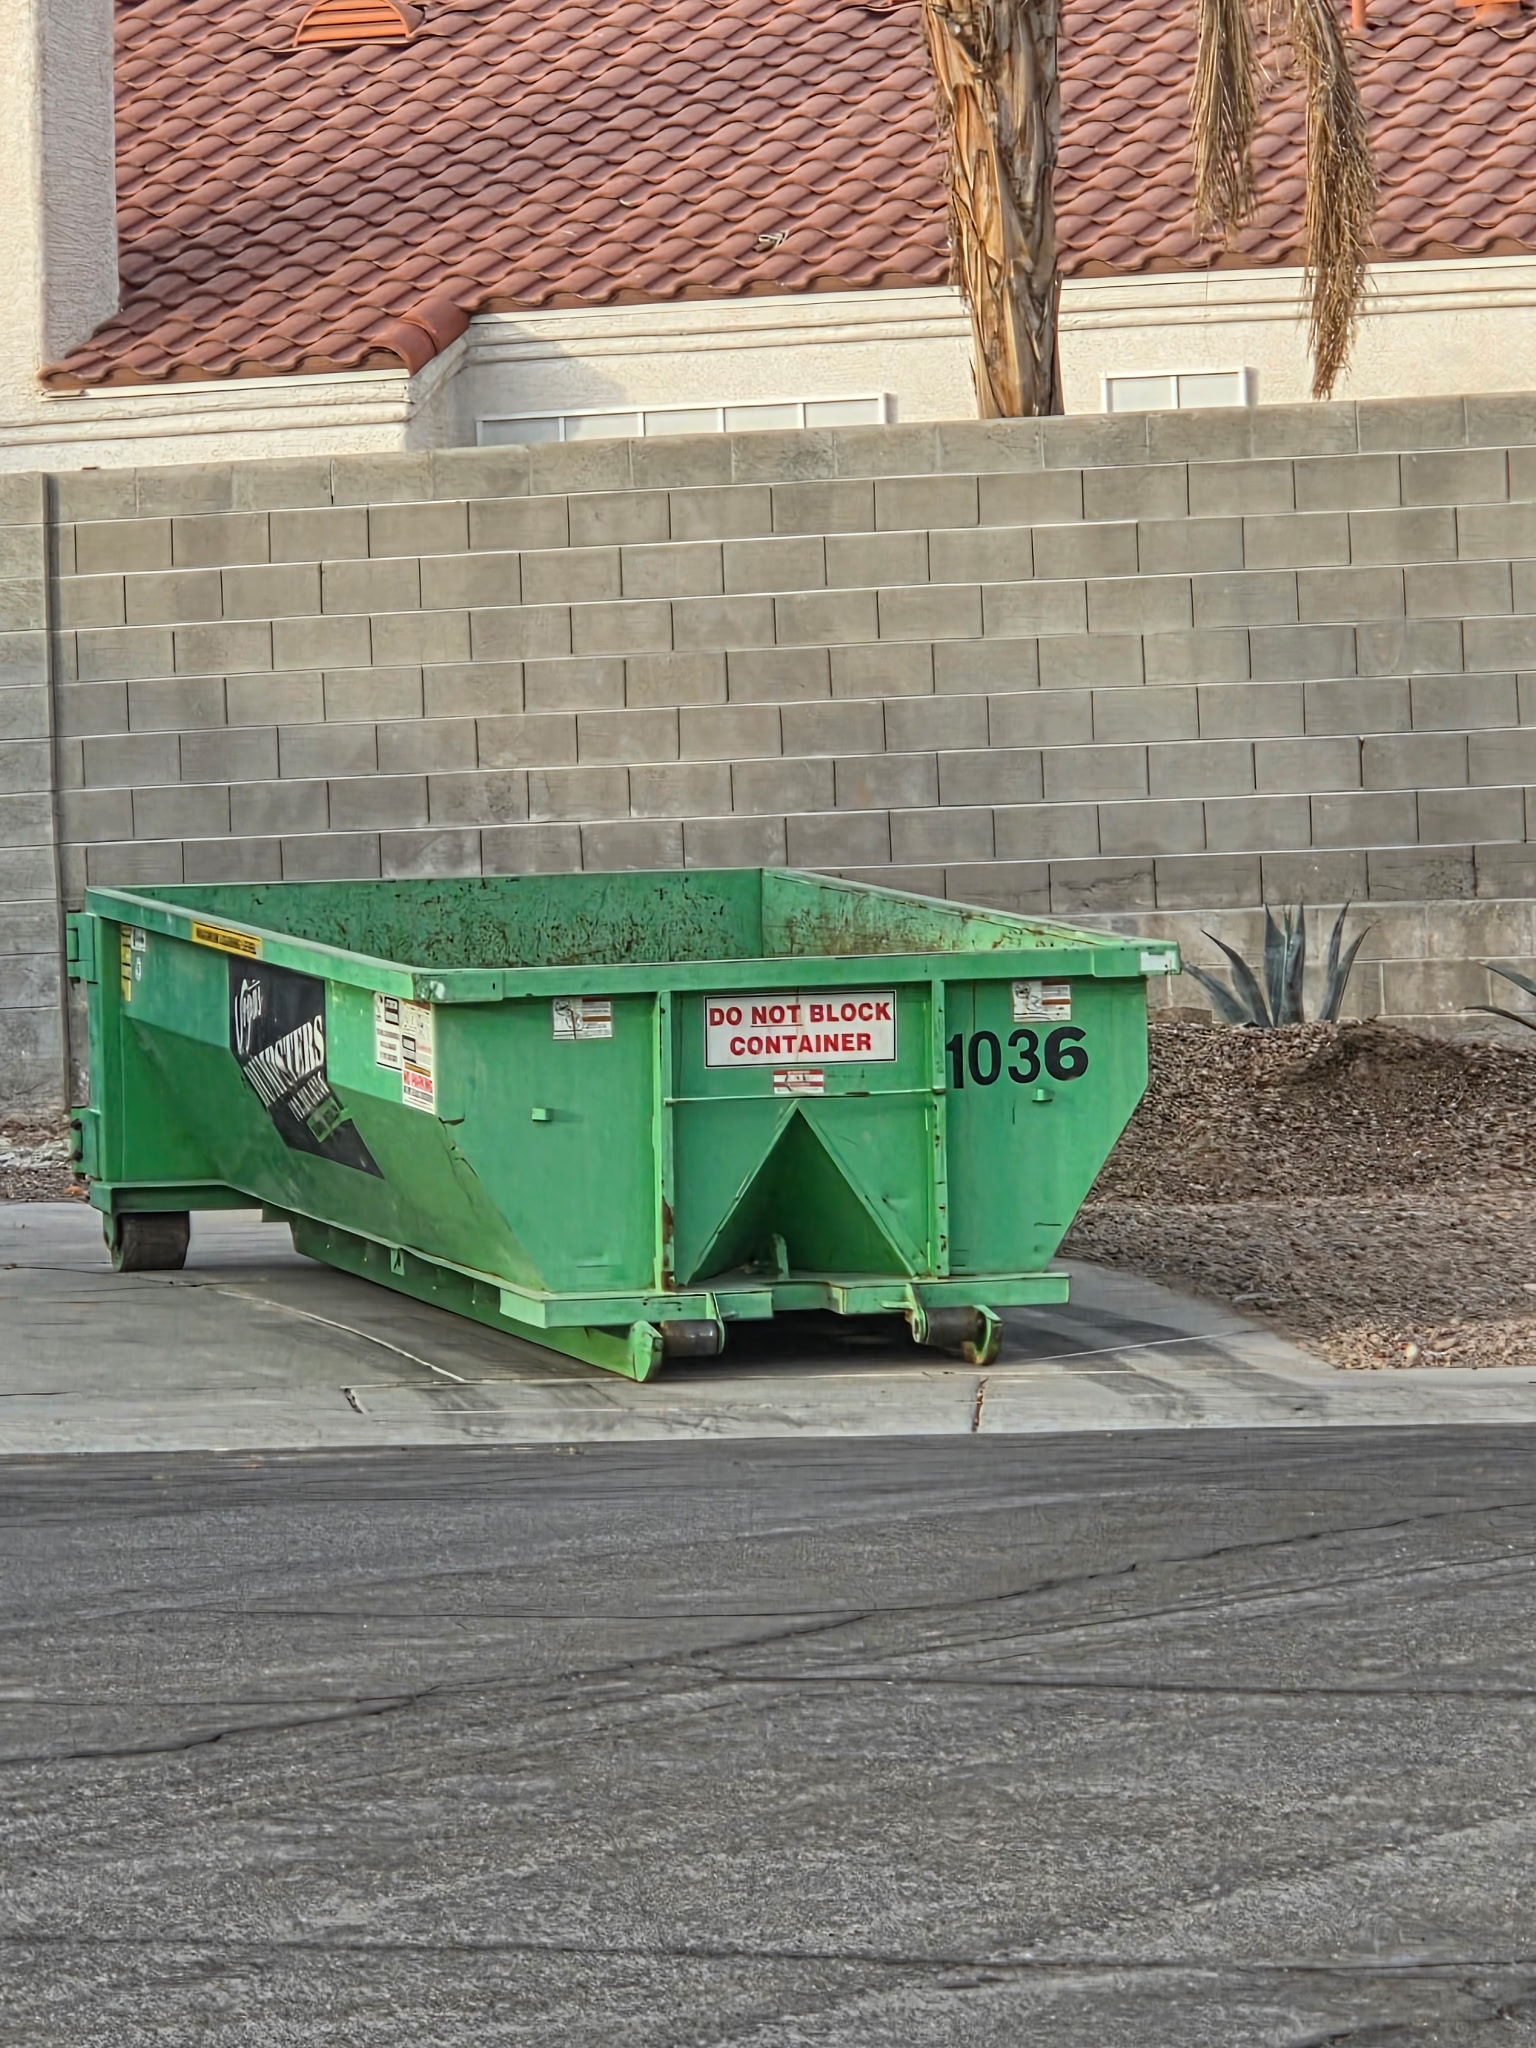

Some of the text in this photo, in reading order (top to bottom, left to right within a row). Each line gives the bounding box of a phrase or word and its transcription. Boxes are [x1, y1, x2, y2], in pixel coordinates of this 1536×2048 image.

[709, 1002, 892, 1026] DO NOT BLOCK
[729, 1033, 872, 1056] CONTAINER
[945, 1026, 1089, 1089] 1036
